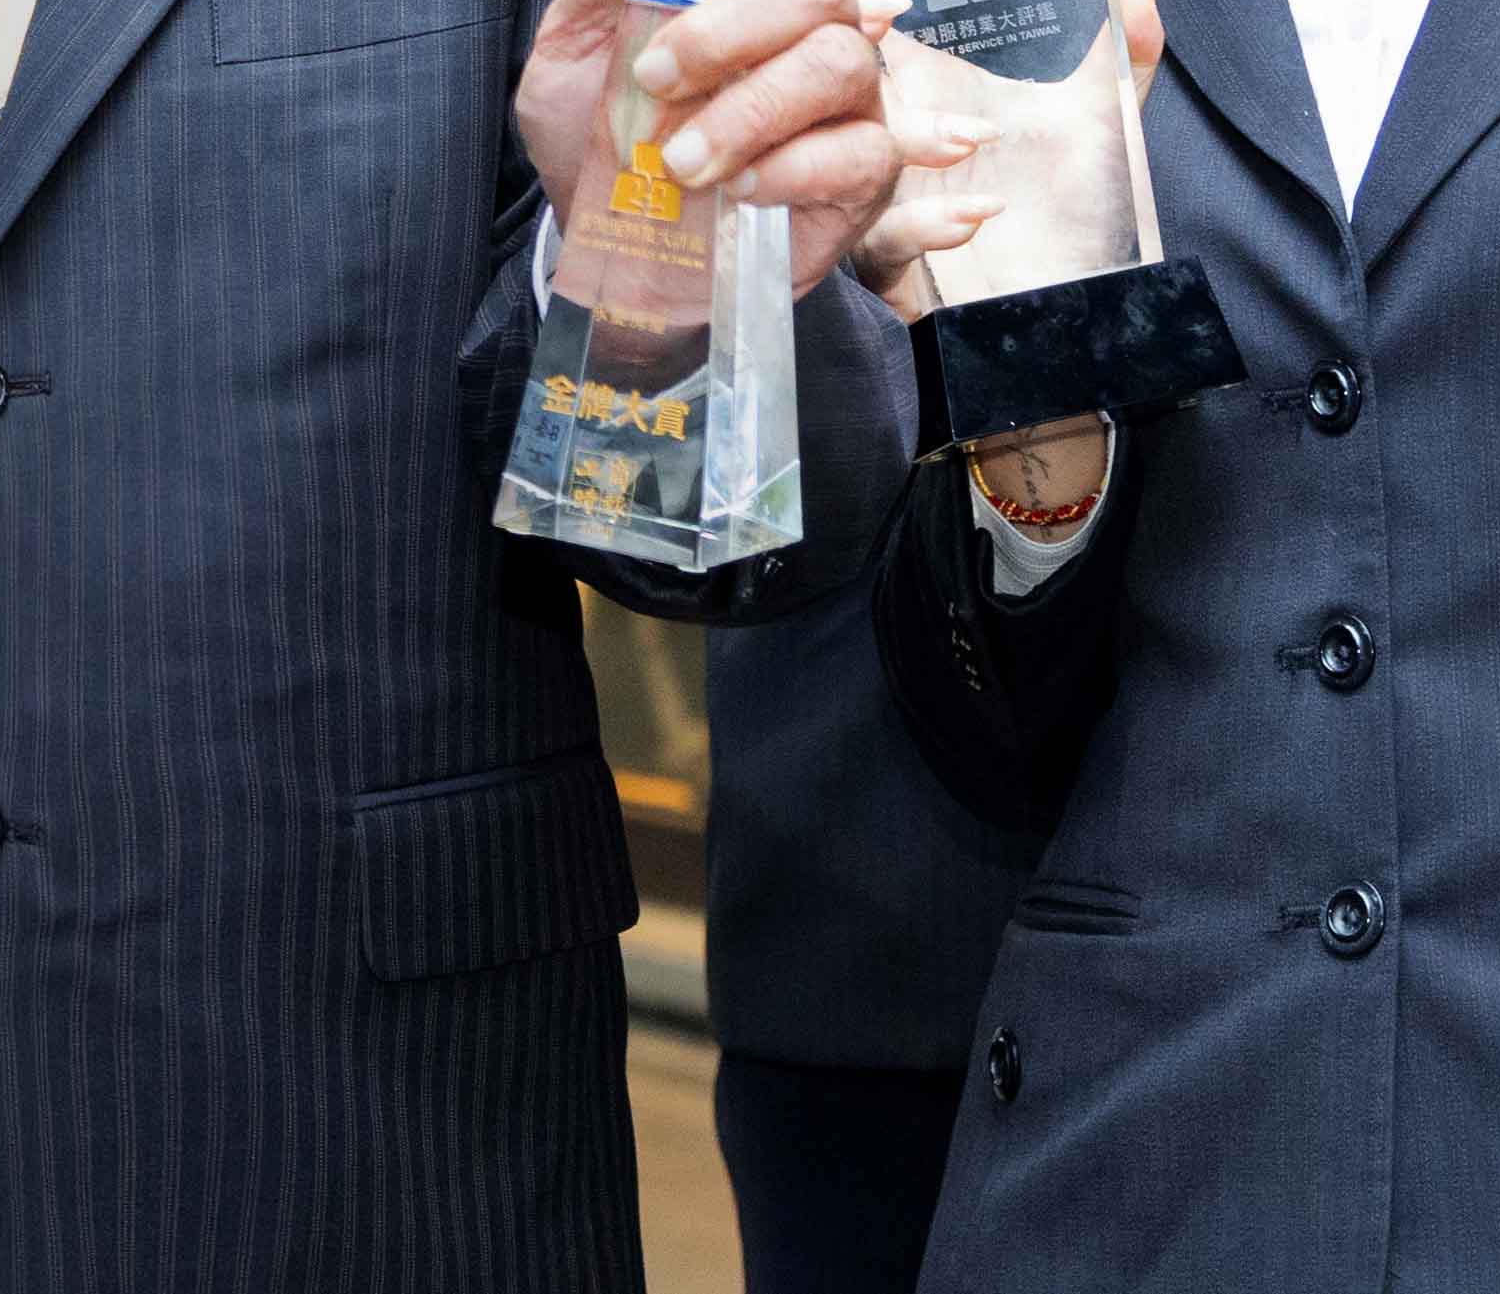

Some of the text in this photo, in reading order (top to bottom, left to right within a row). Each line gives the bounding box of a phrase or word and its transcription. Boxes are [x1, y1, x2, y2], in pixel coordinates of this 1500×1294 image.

[957, 33, 1005, 55] SERVICE
[1006, 32, 1018, 45] IN
[1020, 23, 1062, 42] TAIWAN
[541, 374, 690, 441] 金牌大賞
